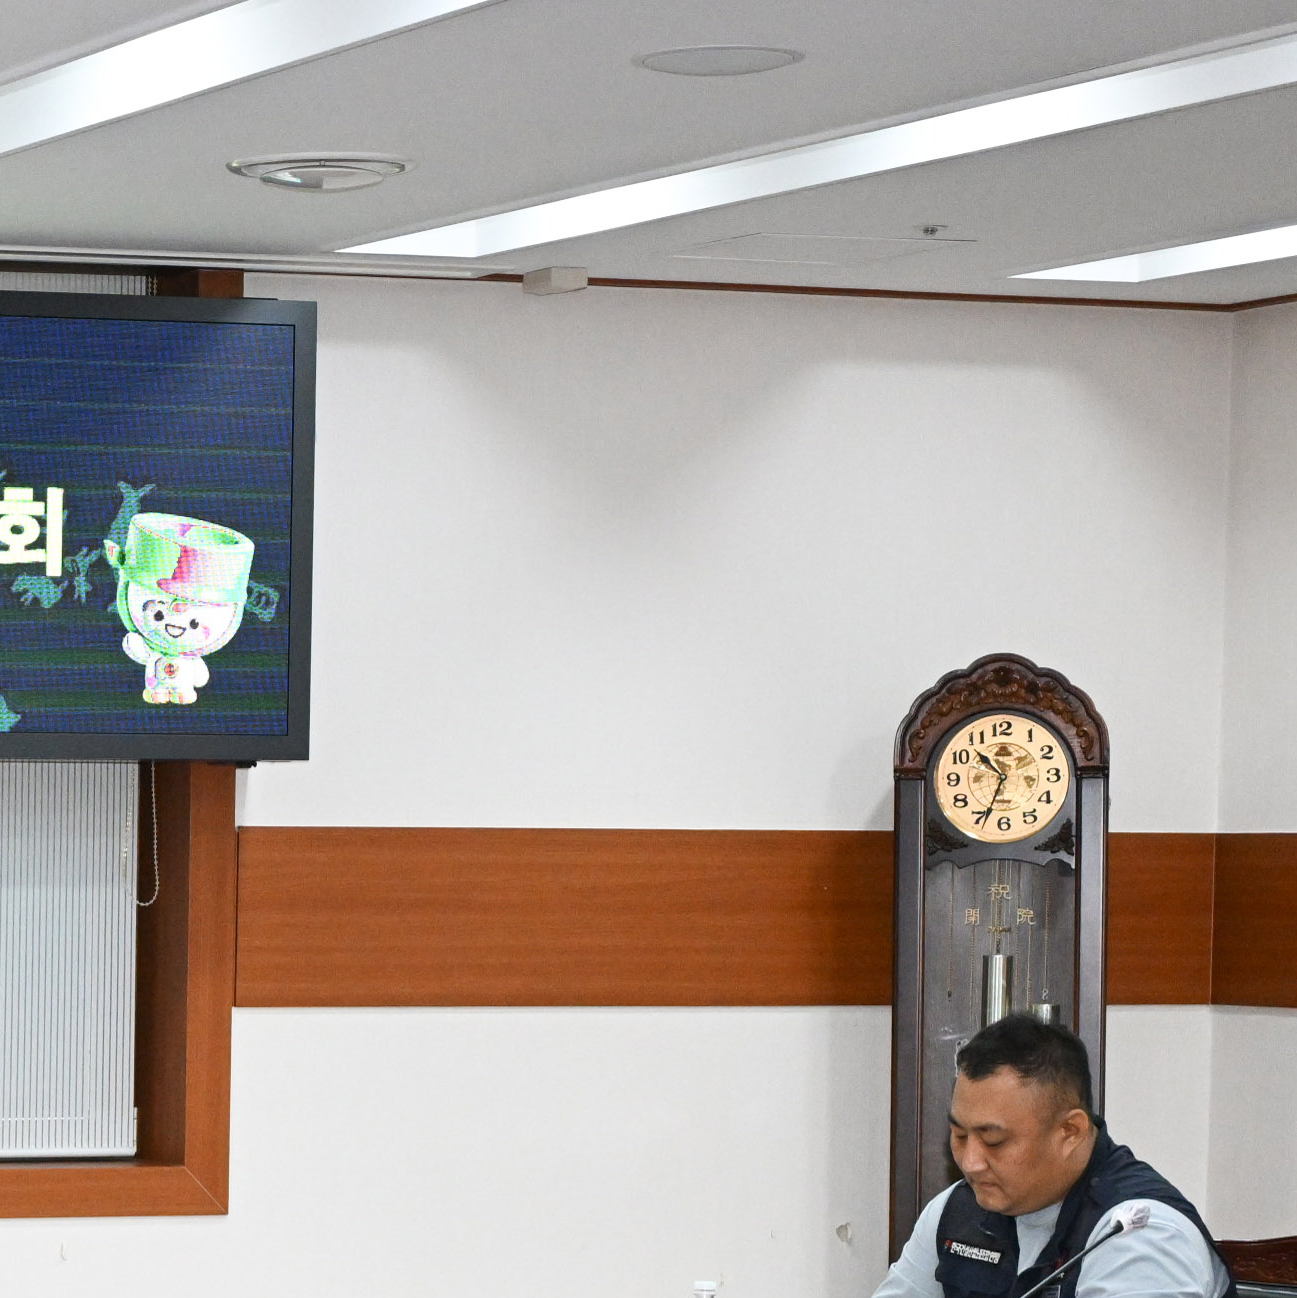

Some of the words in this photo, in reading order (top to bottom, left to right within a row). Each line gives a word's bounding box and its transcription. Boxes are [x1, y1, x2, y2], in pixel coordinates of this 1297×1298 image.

[991, 720, 1013, 737] 12
[1027, 727, 1034, 743] 1
[968, 730, 985, 746] 11
[951, 749, 970, 765] 10
[1039, 745, 1054, 760] 2
[946, 772, 960, 787] 9
[1046, 768, 1061, 783] 3
[953, 793, 968, 808] 8
[1037, 790, 1054, 805] 4
[971, 810, 985, 825] 7
[997, 816, 1011, 832] 6
[1022, 809, 1037, 825] 5
